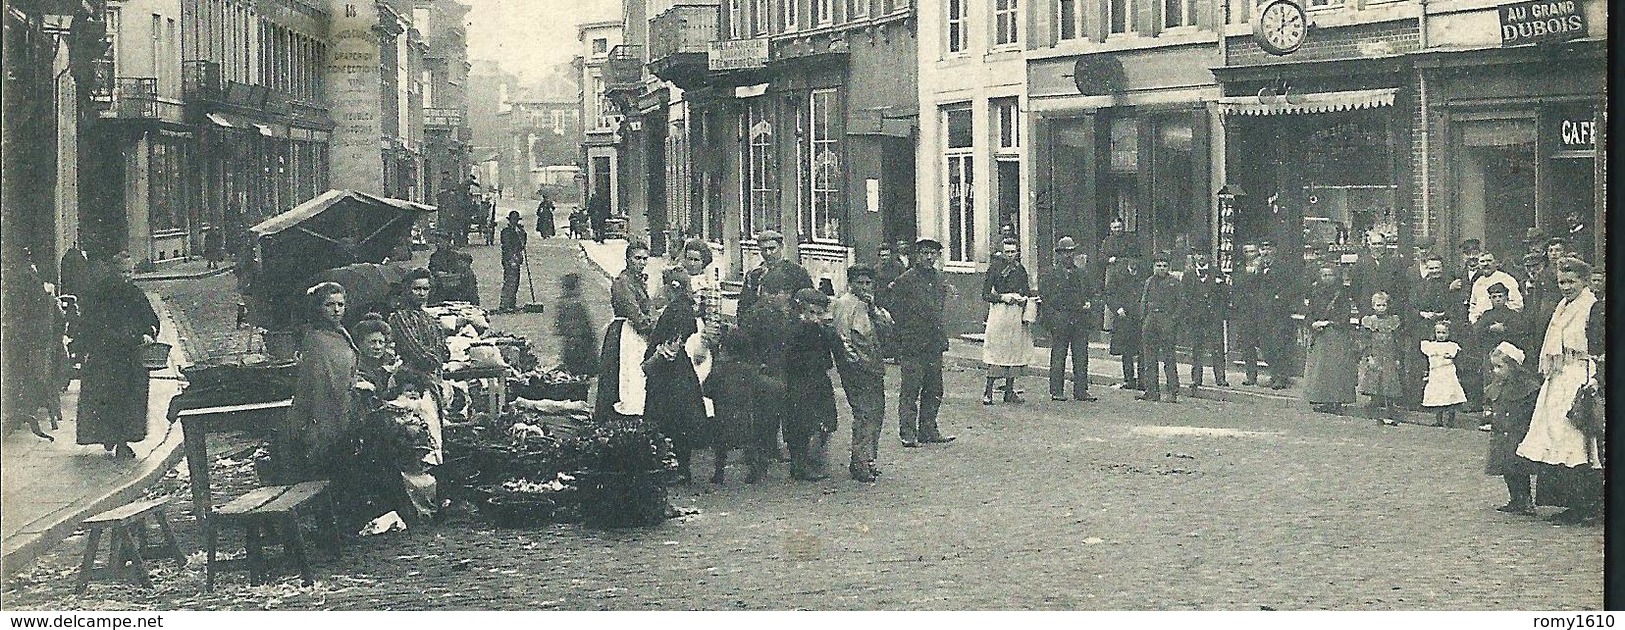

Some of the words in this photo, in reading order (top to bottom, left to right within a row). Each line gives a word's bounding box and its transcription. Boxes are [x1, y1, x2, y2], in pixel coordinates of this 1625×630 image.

[1507, 6, 1527, 22] AU
[1531, 0, 1575, 19] GRAND
[1502, 14, 1583, 42] DUBOIS
